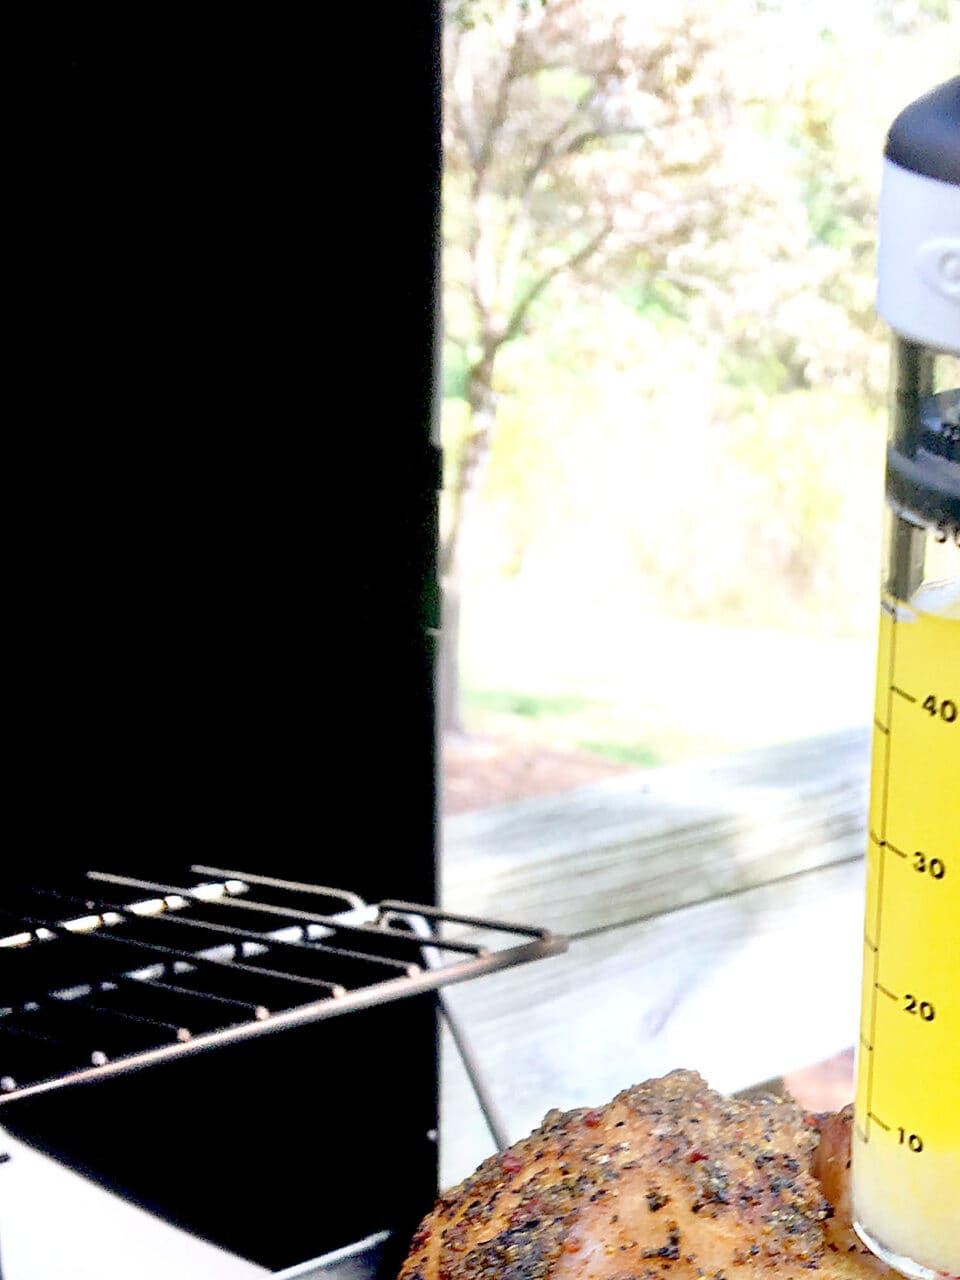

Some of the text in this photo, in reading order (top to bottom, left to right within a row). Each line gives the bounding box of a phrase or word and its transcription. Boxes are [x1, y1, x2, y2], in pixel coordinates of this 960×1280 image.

[921, 694, 959, 724] 40
[912, 850, 946, 881] 30
[903, 993, 936, 1023] 20
[896, 1126, 924, 1154] 10
